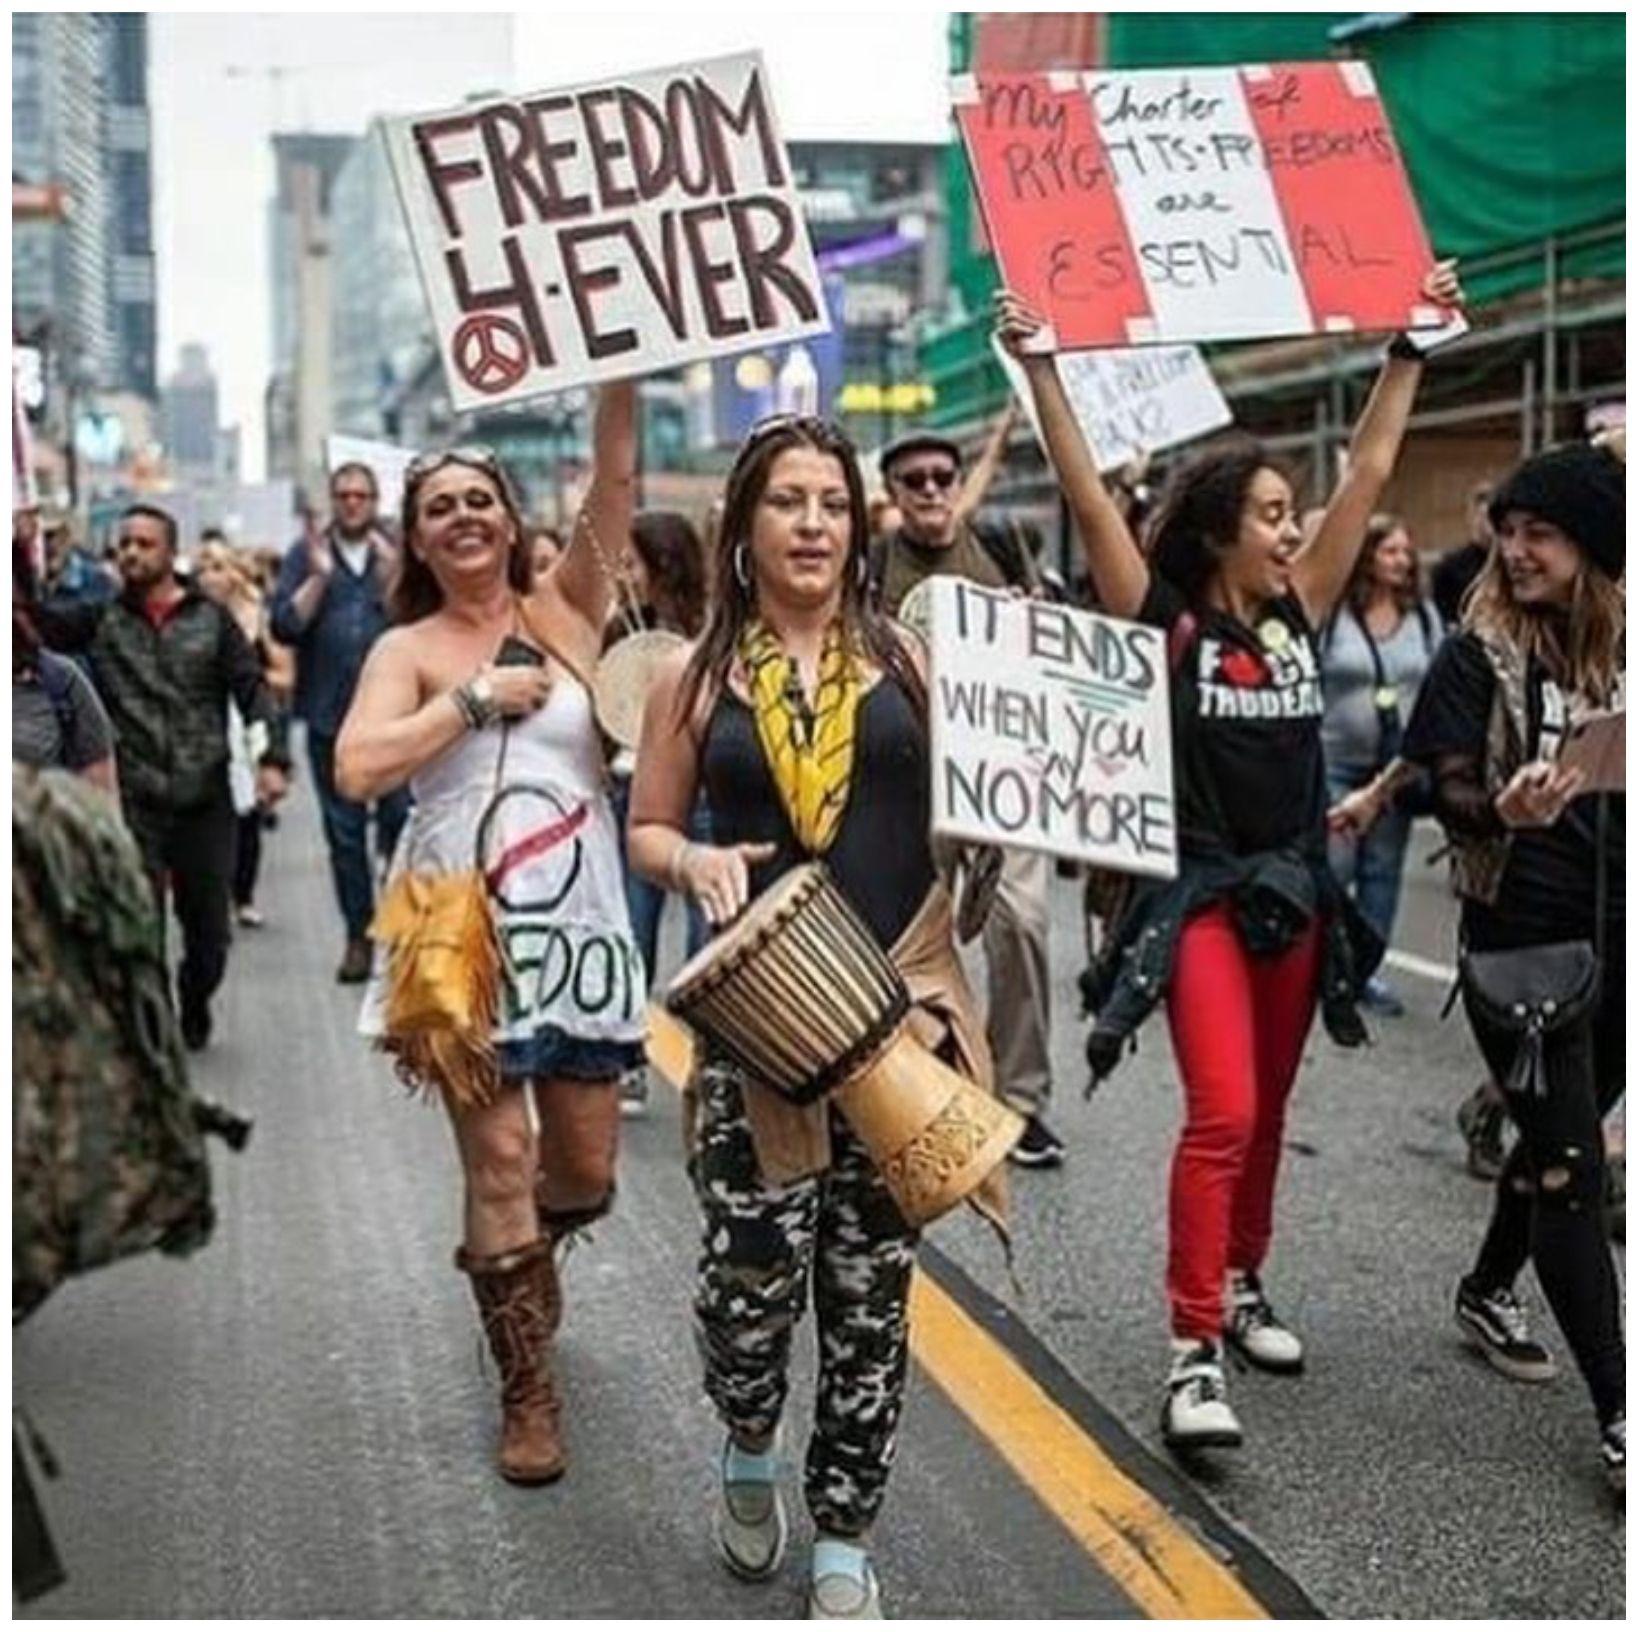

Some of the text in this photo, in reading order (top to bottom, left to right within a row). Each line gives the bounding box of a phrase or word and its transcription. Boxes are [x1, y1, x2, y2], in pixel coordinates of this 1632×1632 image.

[1091, 75, 1223, 126] Charter
[1254, 73, 1302, 118] of
[412, 67, 787, 239] FREEDOM
[1155, 191, 1234, 214] are
[1049, 223, 1393, 298] ESSENTIAL
[955, 583, 1156, 690] IT ENDS
[939, 677, 1049, 745] WHEN
[944, 755, 1171, 856] NO MORE
